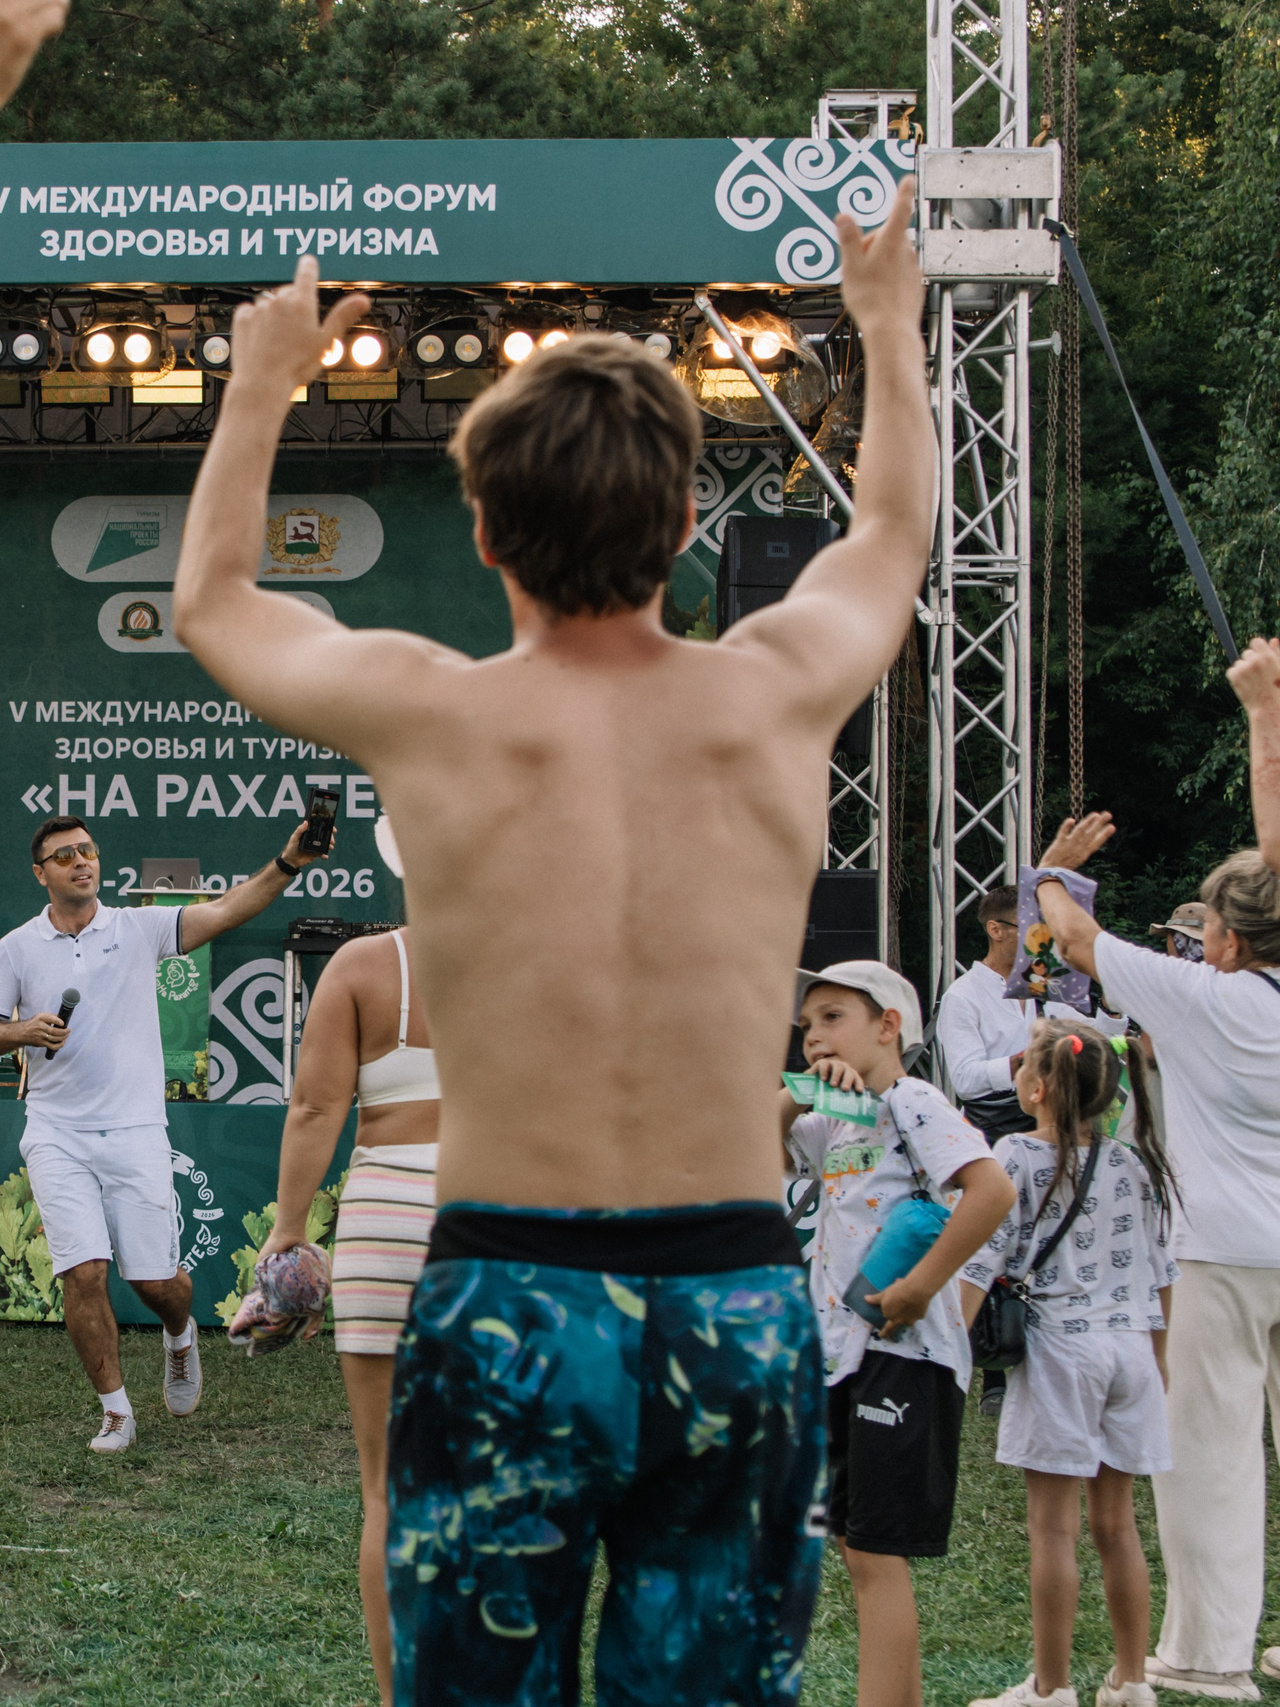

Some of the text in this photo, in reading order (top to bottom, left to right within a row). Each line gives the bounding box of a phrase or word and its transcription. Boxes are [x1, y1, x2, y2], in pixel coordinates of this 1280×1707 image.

[20, 177, 353, 218] МЕЖДУНАРОДНЫЙ
[362, 184, 496, 213] ФОРУМ
[40, 228, 439, 260] ЗДОРОВЬЯ И ТУРИЗМА
[109, 523, 158, 531] НАЦИОНАЛЬНЫЕ
[130, 531, 159, 539] ПРОЕКТЫ
[9, 701, 262, 726] V МЕЖДУНАРОД
[55, 738, 350, 763] ЗДОРОВЬЯ И ТУРИЗ
[21, 774, 387, 818] «НА РАХАТЕ
[282, 867, 375, 898] 2026
[856, 1403, 897, 1427] PUMA
